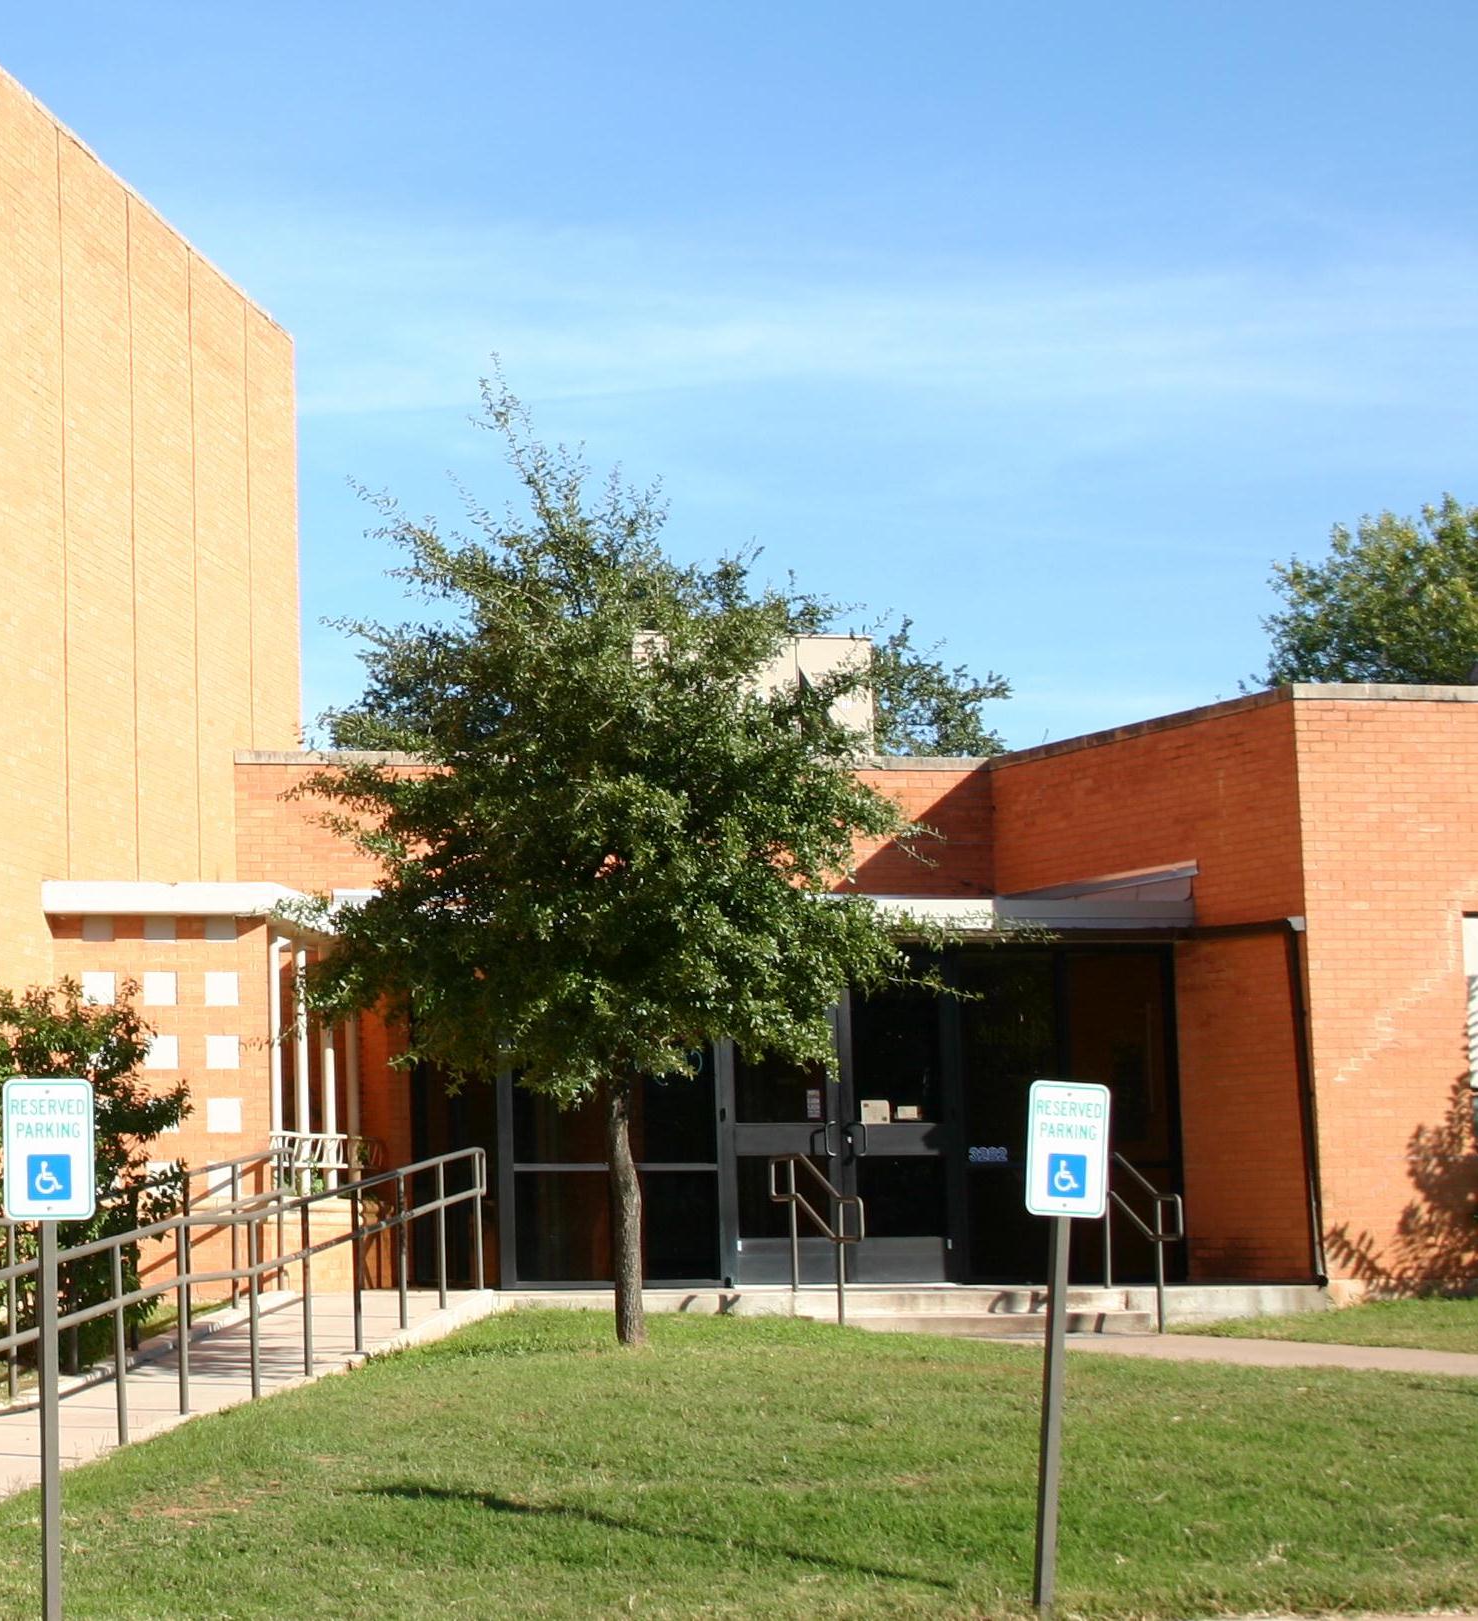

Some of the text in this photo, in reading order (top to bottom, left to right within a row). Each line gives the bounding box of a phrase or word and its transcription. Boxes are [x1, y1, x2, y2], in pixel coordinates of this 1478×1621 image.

[10, 1099, 85, 1116] RESERVED
[1036, 1099, 1103, 1119] RESERVED
[16, 1122, 81, 1139] PARKING
[1039, 1122, 1098, 1141] PARKING
